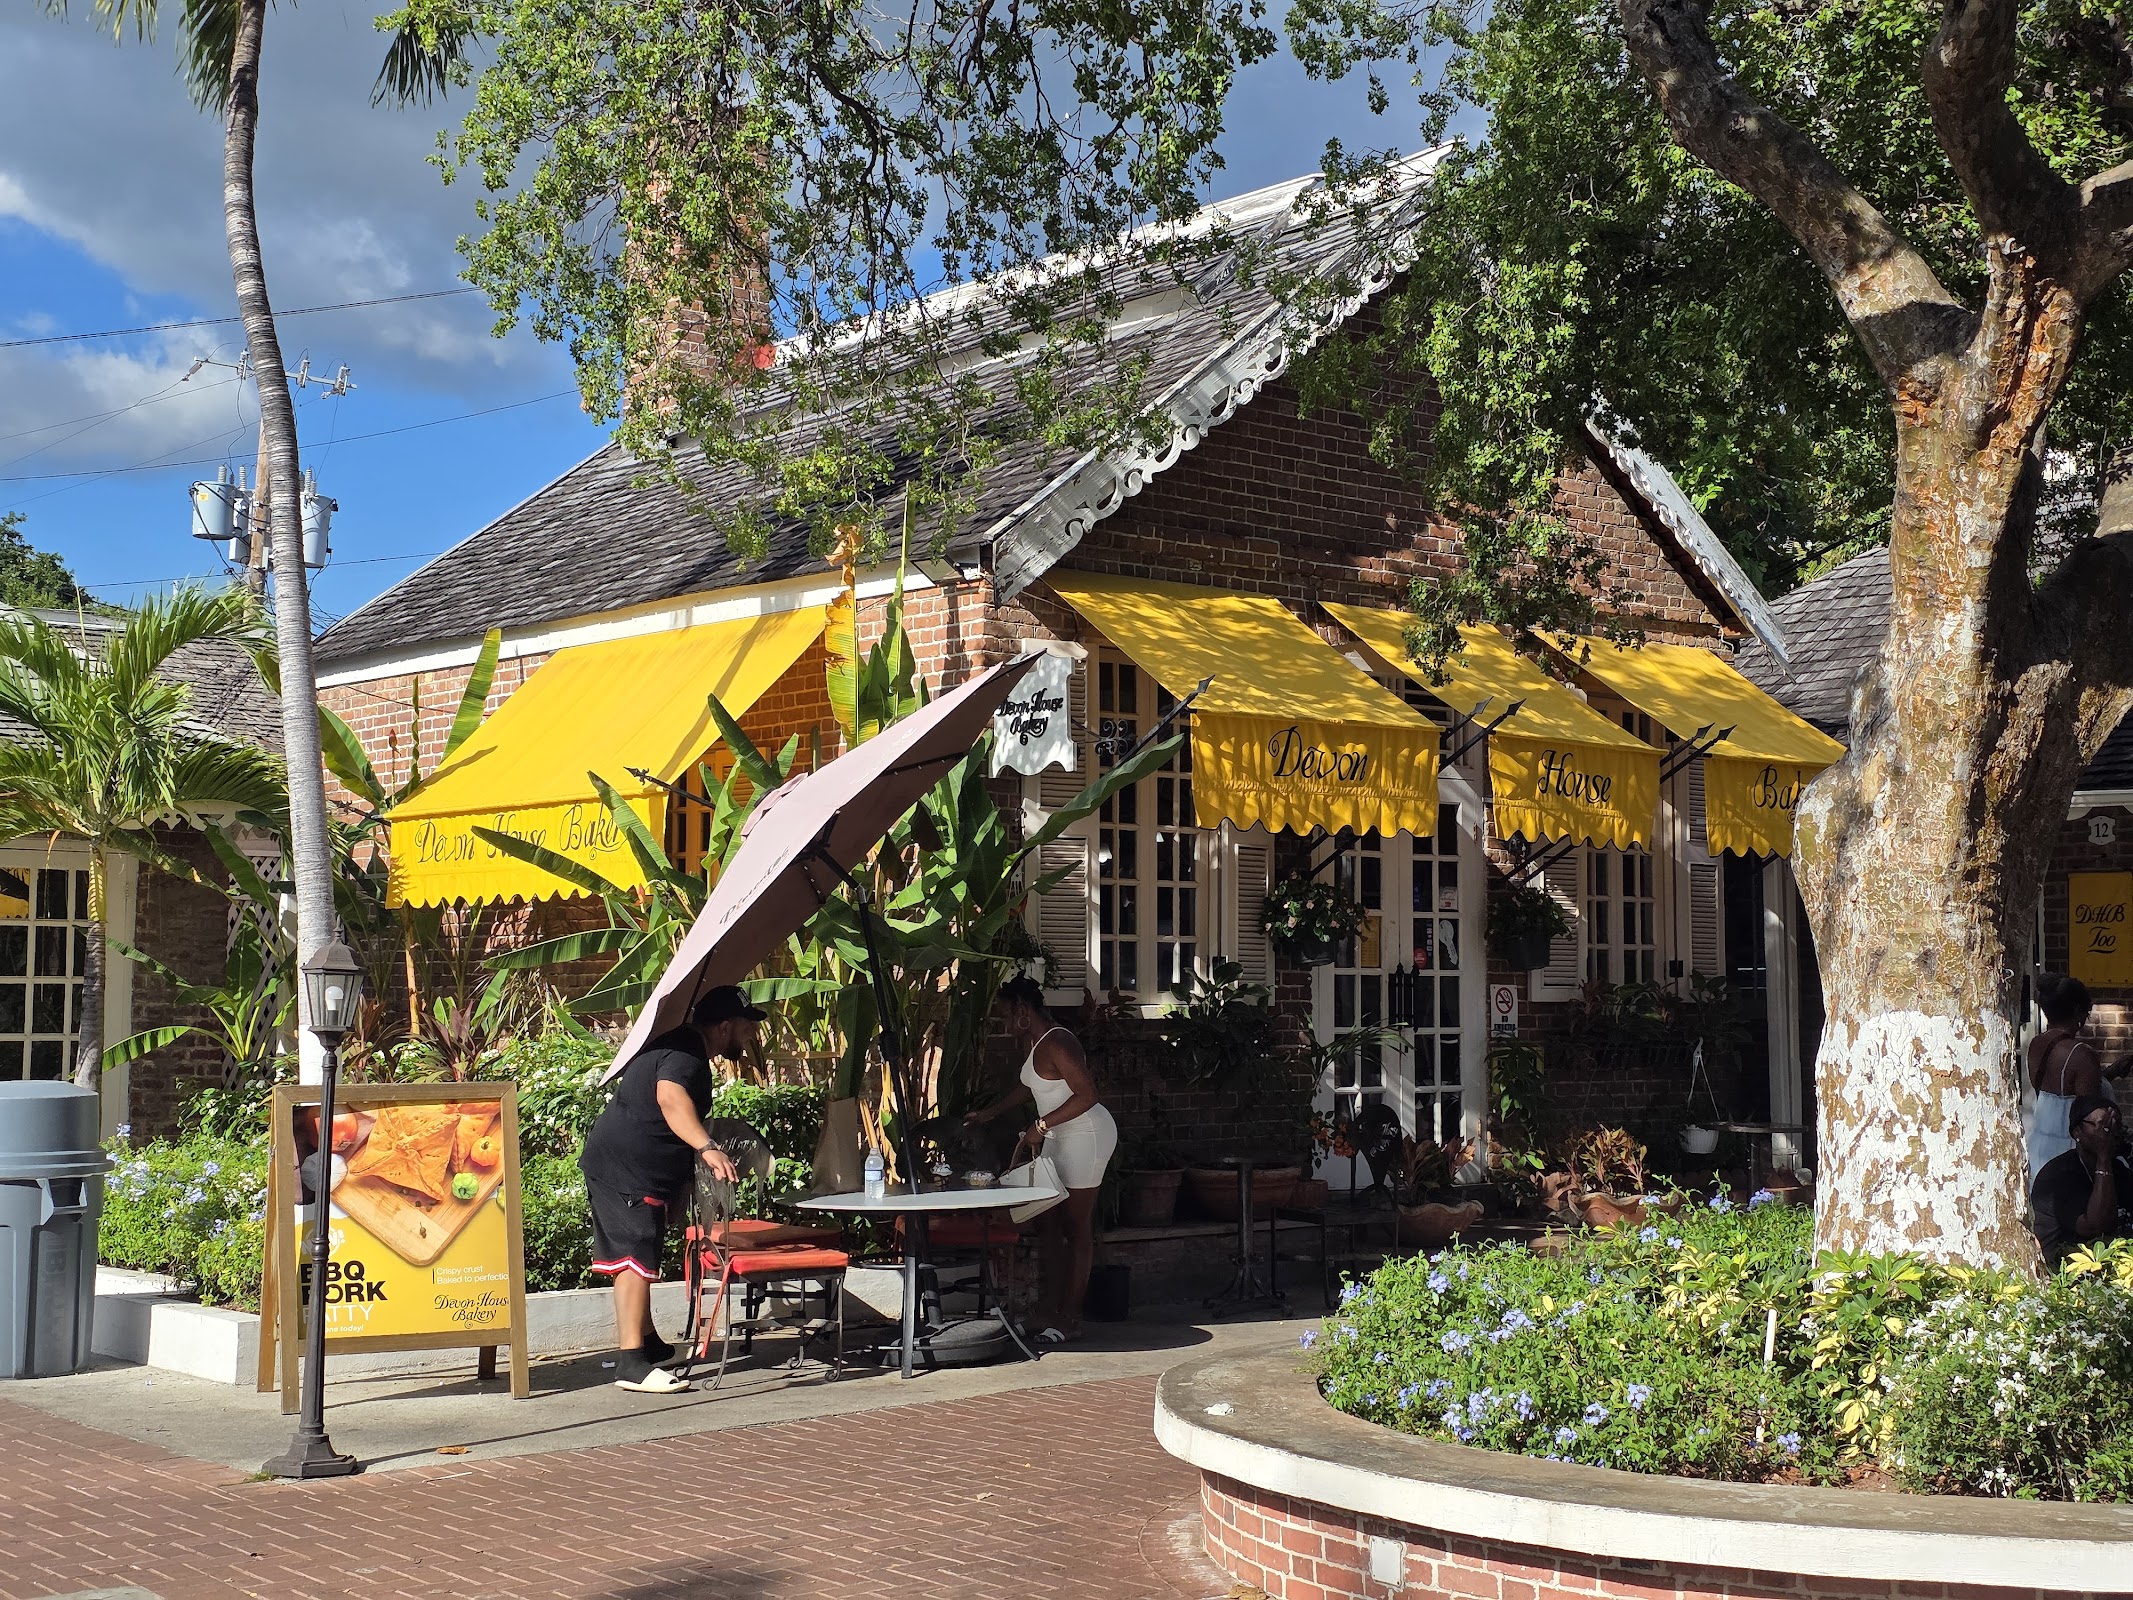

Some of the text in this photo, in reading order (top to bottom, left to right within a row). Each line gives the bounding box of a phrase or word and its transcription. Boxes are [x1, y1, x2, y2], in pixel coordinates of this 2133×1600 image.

[1268, 725, 1368, 781] Devon
[1537, 749, 1611, 804] House
[1753, 763, 1806, 825] Bak
[2093, 822, 2109, 838] 12
[2075, 902, 2127, 924] DHB
[2089, 926, 2116, 948] Too
[436, 1265, 483, 1276] Crispy crust
[437, 1272, 509, 1285] Baked to perfectio
[434, 1290, 510, 1310] Devon Hous
[340, 1324, 364, 1333] today!
[451, 1307, 497, 1329] Bakery
